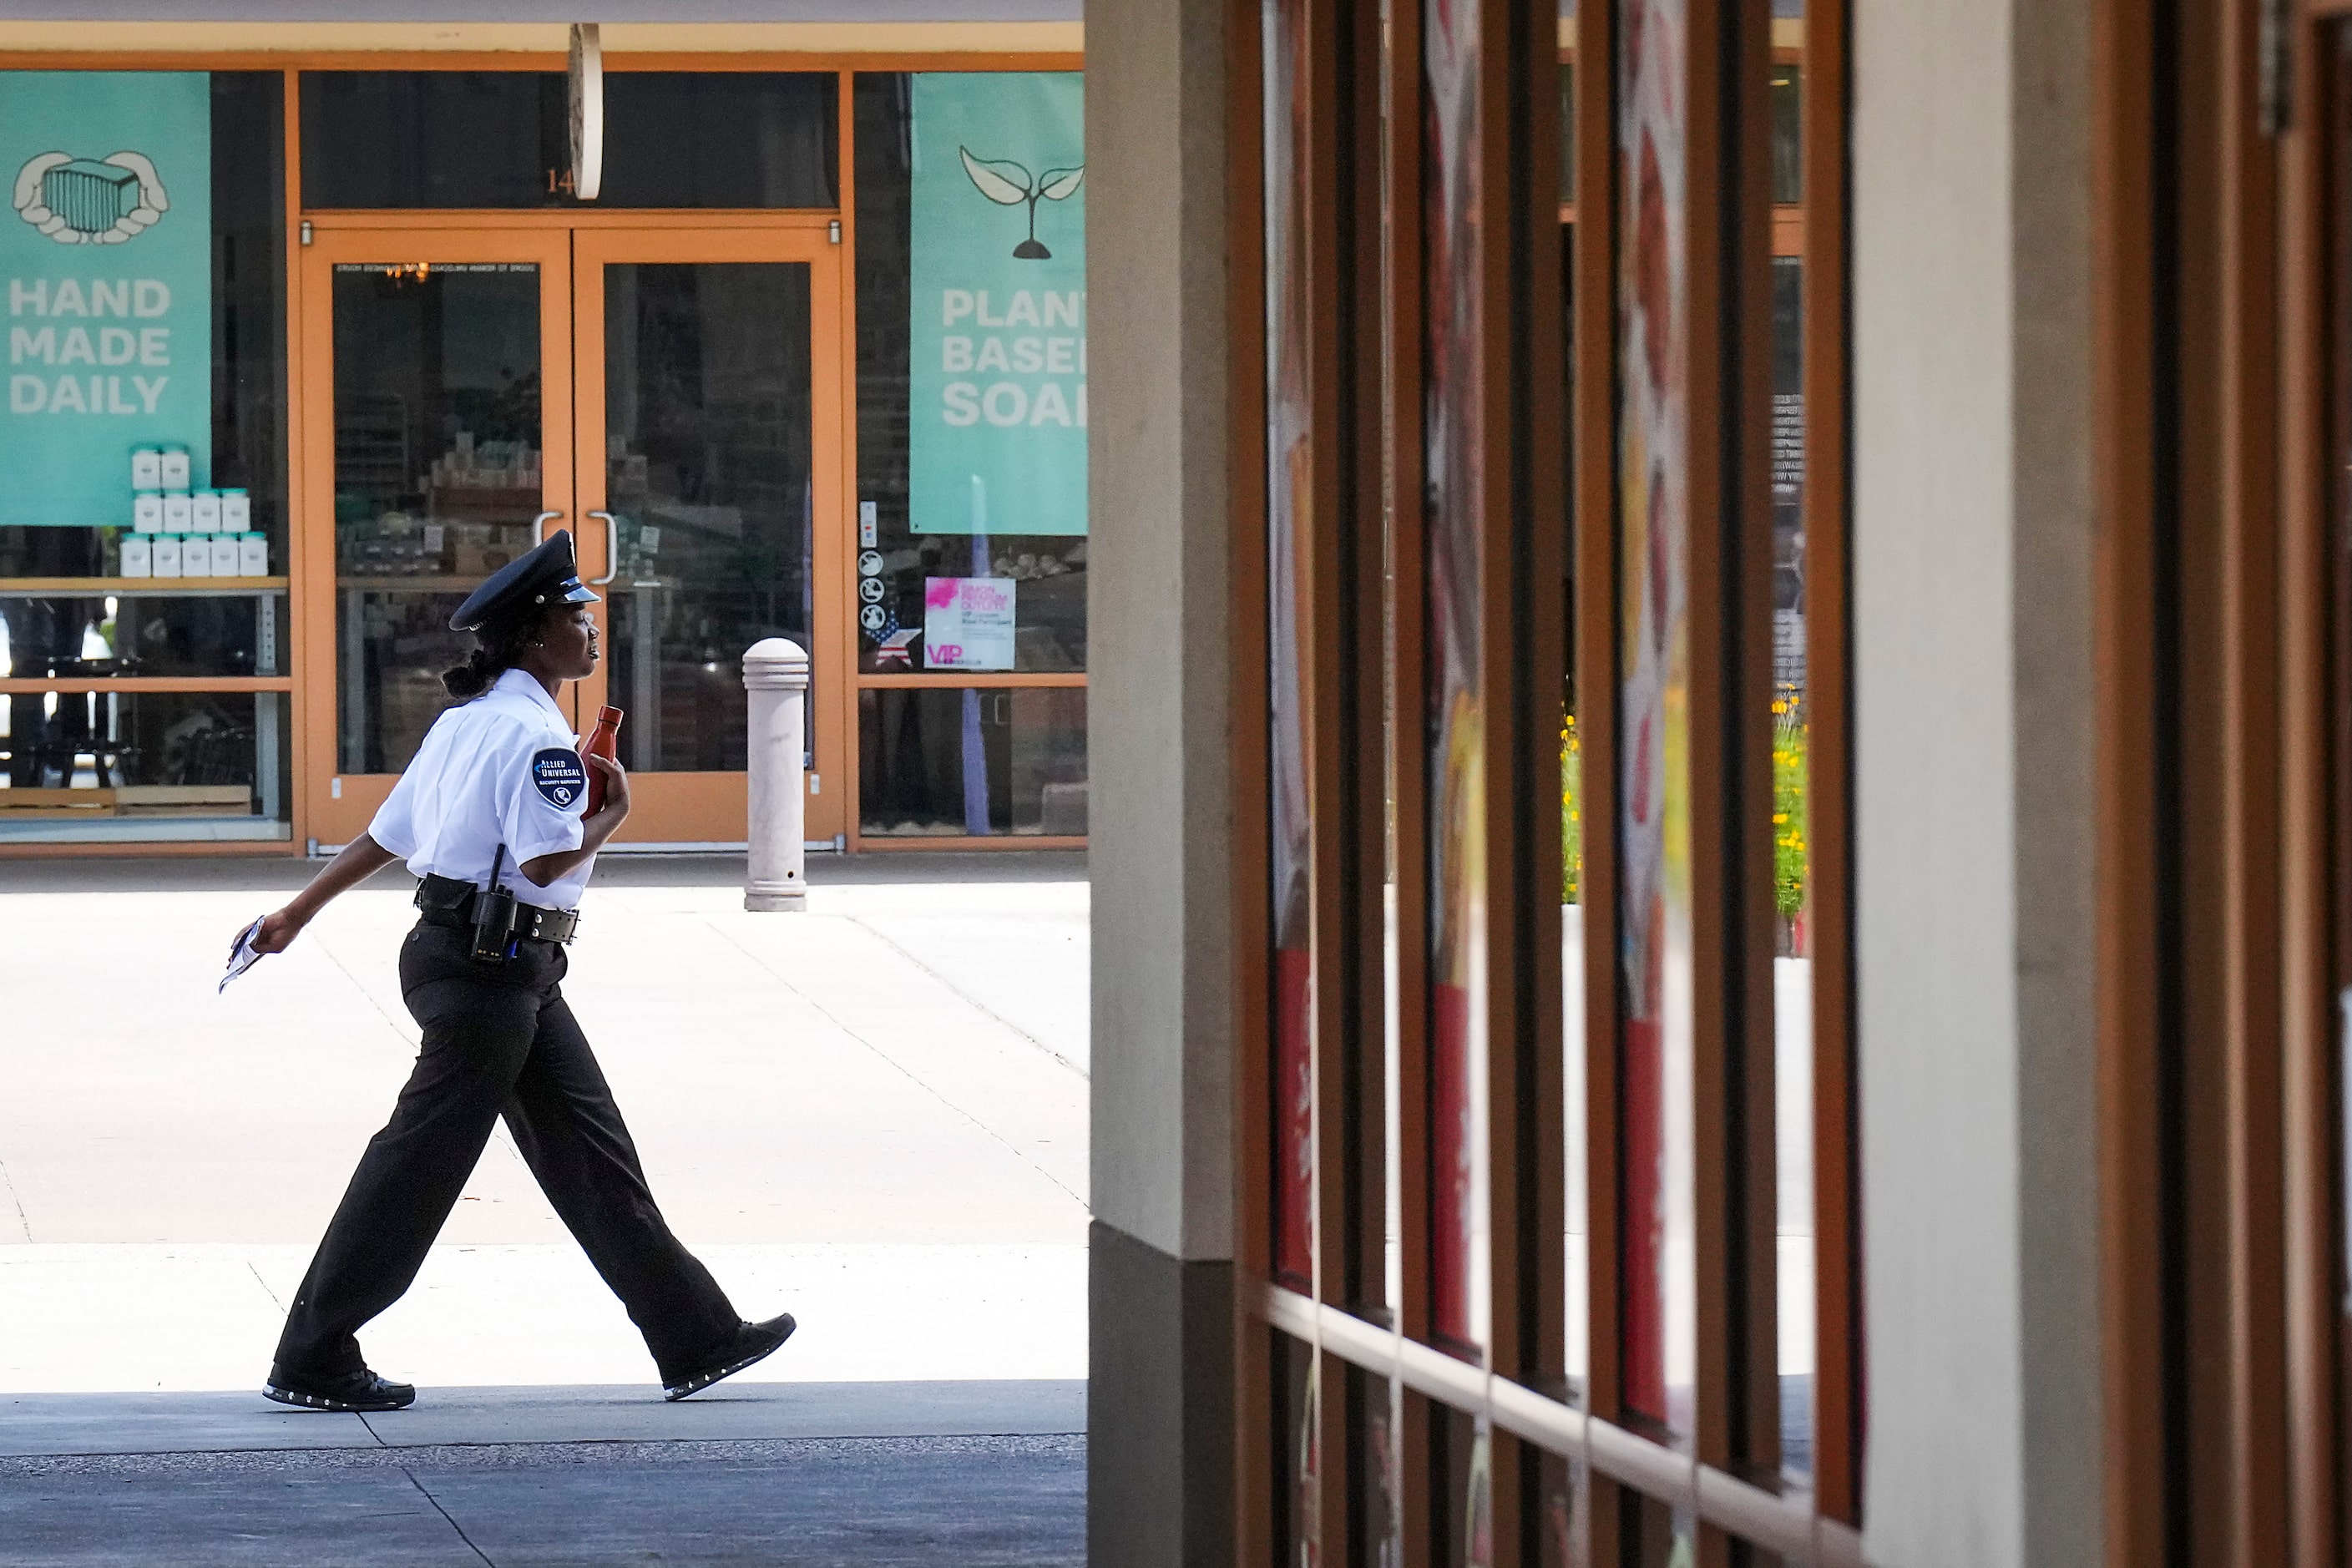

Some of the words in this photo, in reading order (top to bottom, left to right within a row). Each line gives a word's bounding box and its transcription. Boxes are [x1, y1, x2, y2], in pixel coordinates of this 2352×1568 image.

[10, 278, 171, 318] HAND
[943, 289, 1086, 327] PLAN
[10, 326, 171, 366] MADE
[943, 336, 1087, 374] BASE
[10, 374, 169, 414] DAILY
[927, 644, 964, 665] VIP
[541, 760, 566, 768] ALLIED
[541, 769, 581, 777] UNIVERSAL
